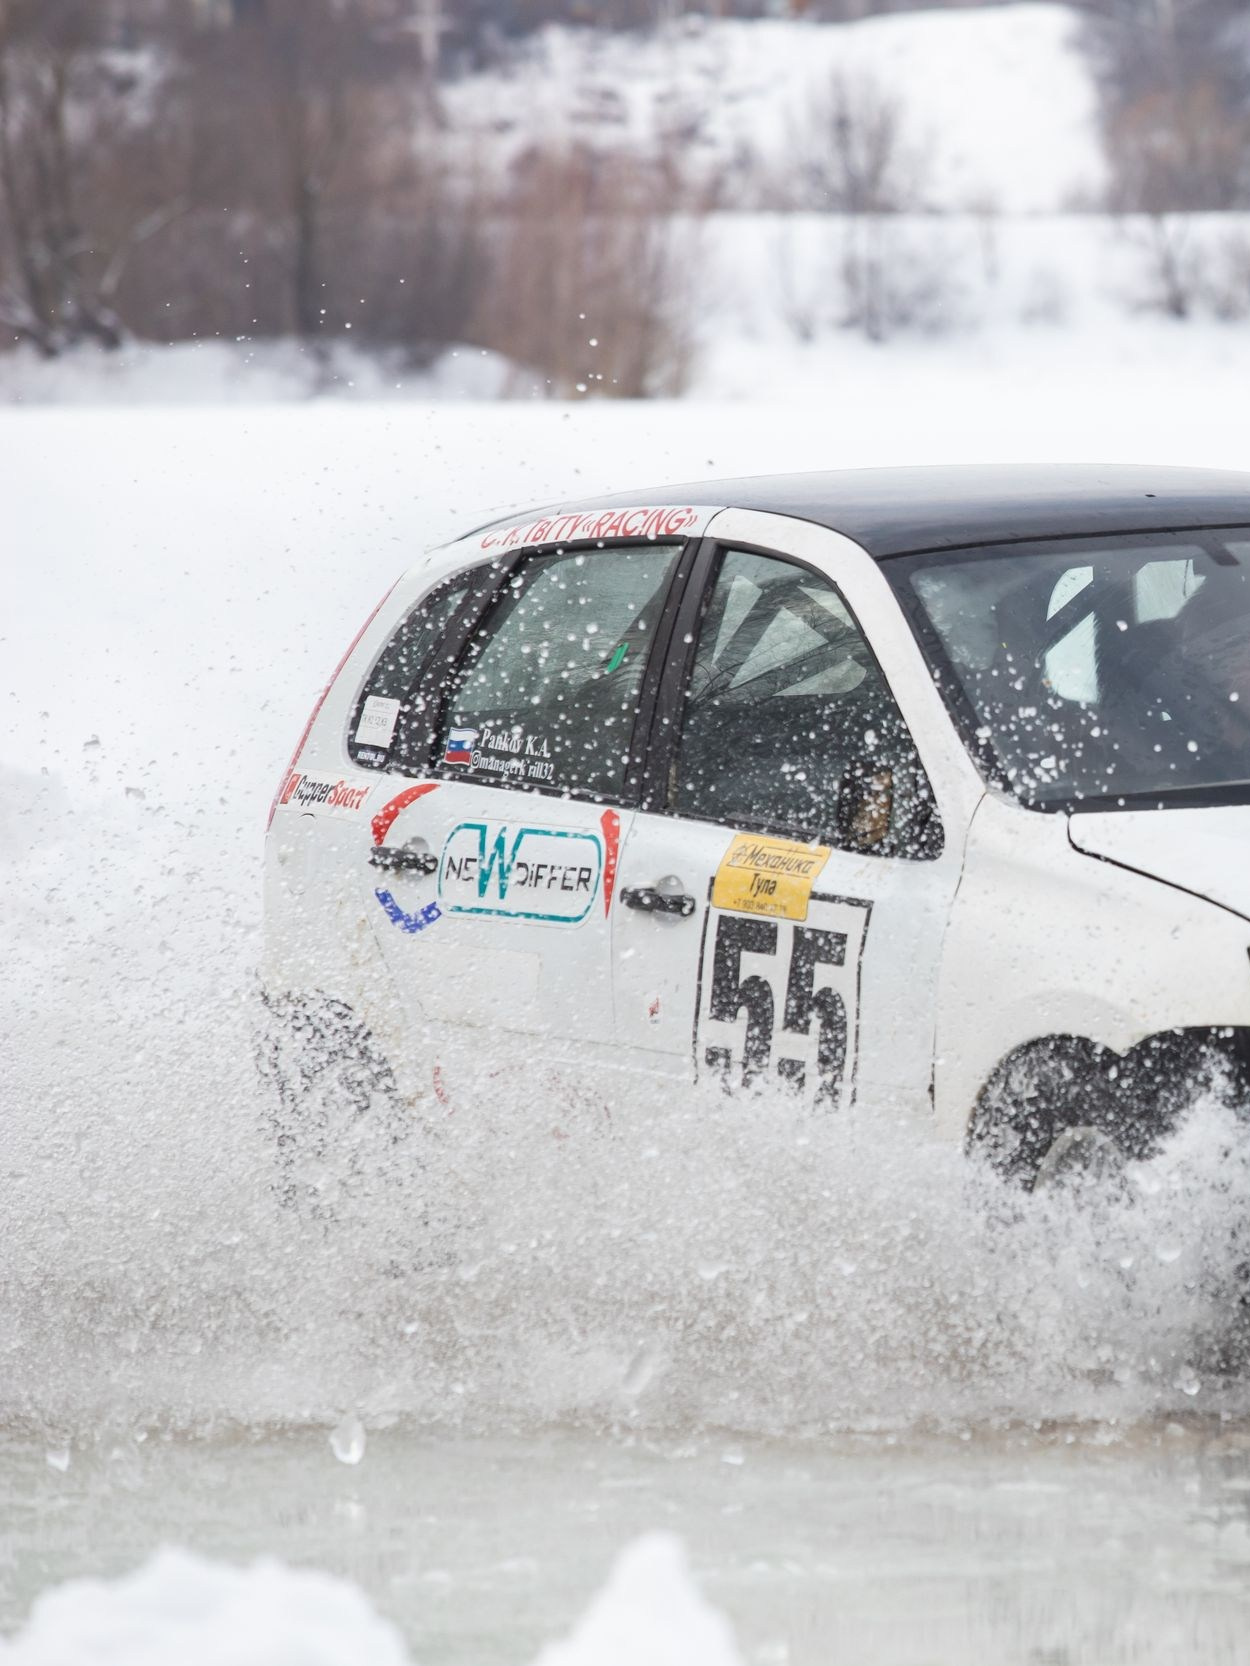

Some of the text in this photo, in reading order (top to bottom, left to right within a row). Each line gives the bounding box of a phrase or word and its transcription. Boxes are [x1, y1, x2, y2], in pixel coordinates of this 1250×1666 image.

[524, 734, 552, 758] K.A.
[749, 872, 777, 898] Тула
[704, 914, 848, 1106] 55
